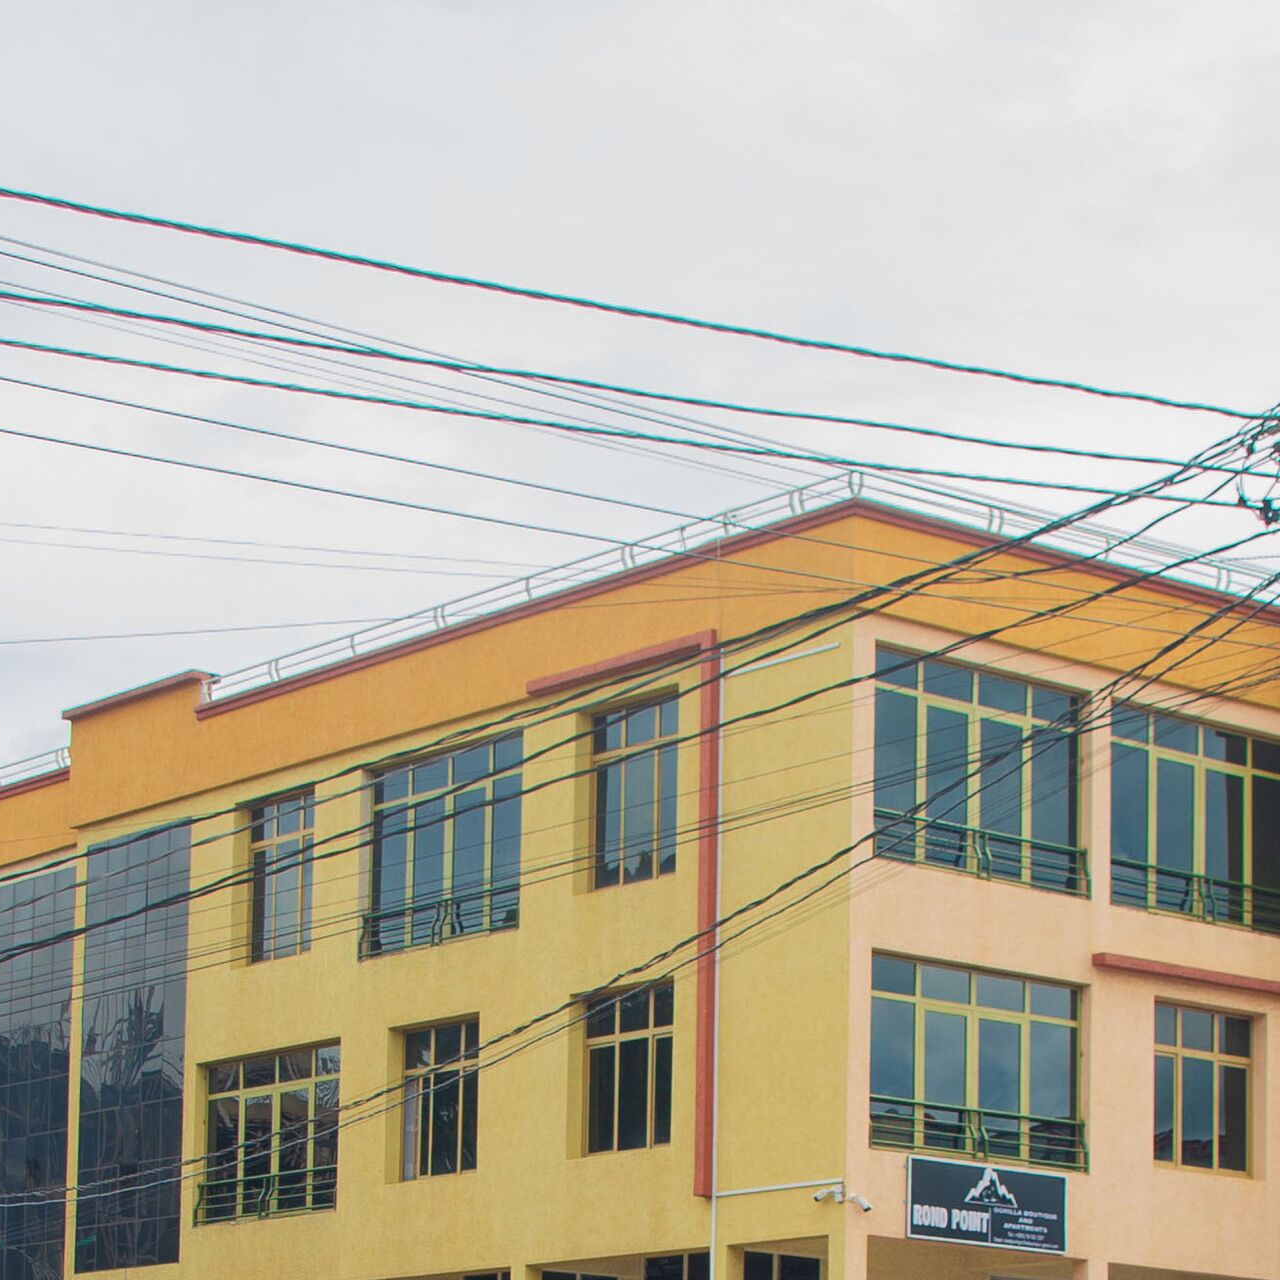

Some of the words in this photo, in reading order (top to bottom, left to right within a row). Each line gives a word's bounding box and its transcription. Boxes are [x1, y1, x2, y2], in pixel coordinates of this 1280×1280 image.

[912, 1203, 949, 1229] ROND
[950, 1207, 990, 1234] POINT
[993, 1206, 1022, 1217] GORILLA
